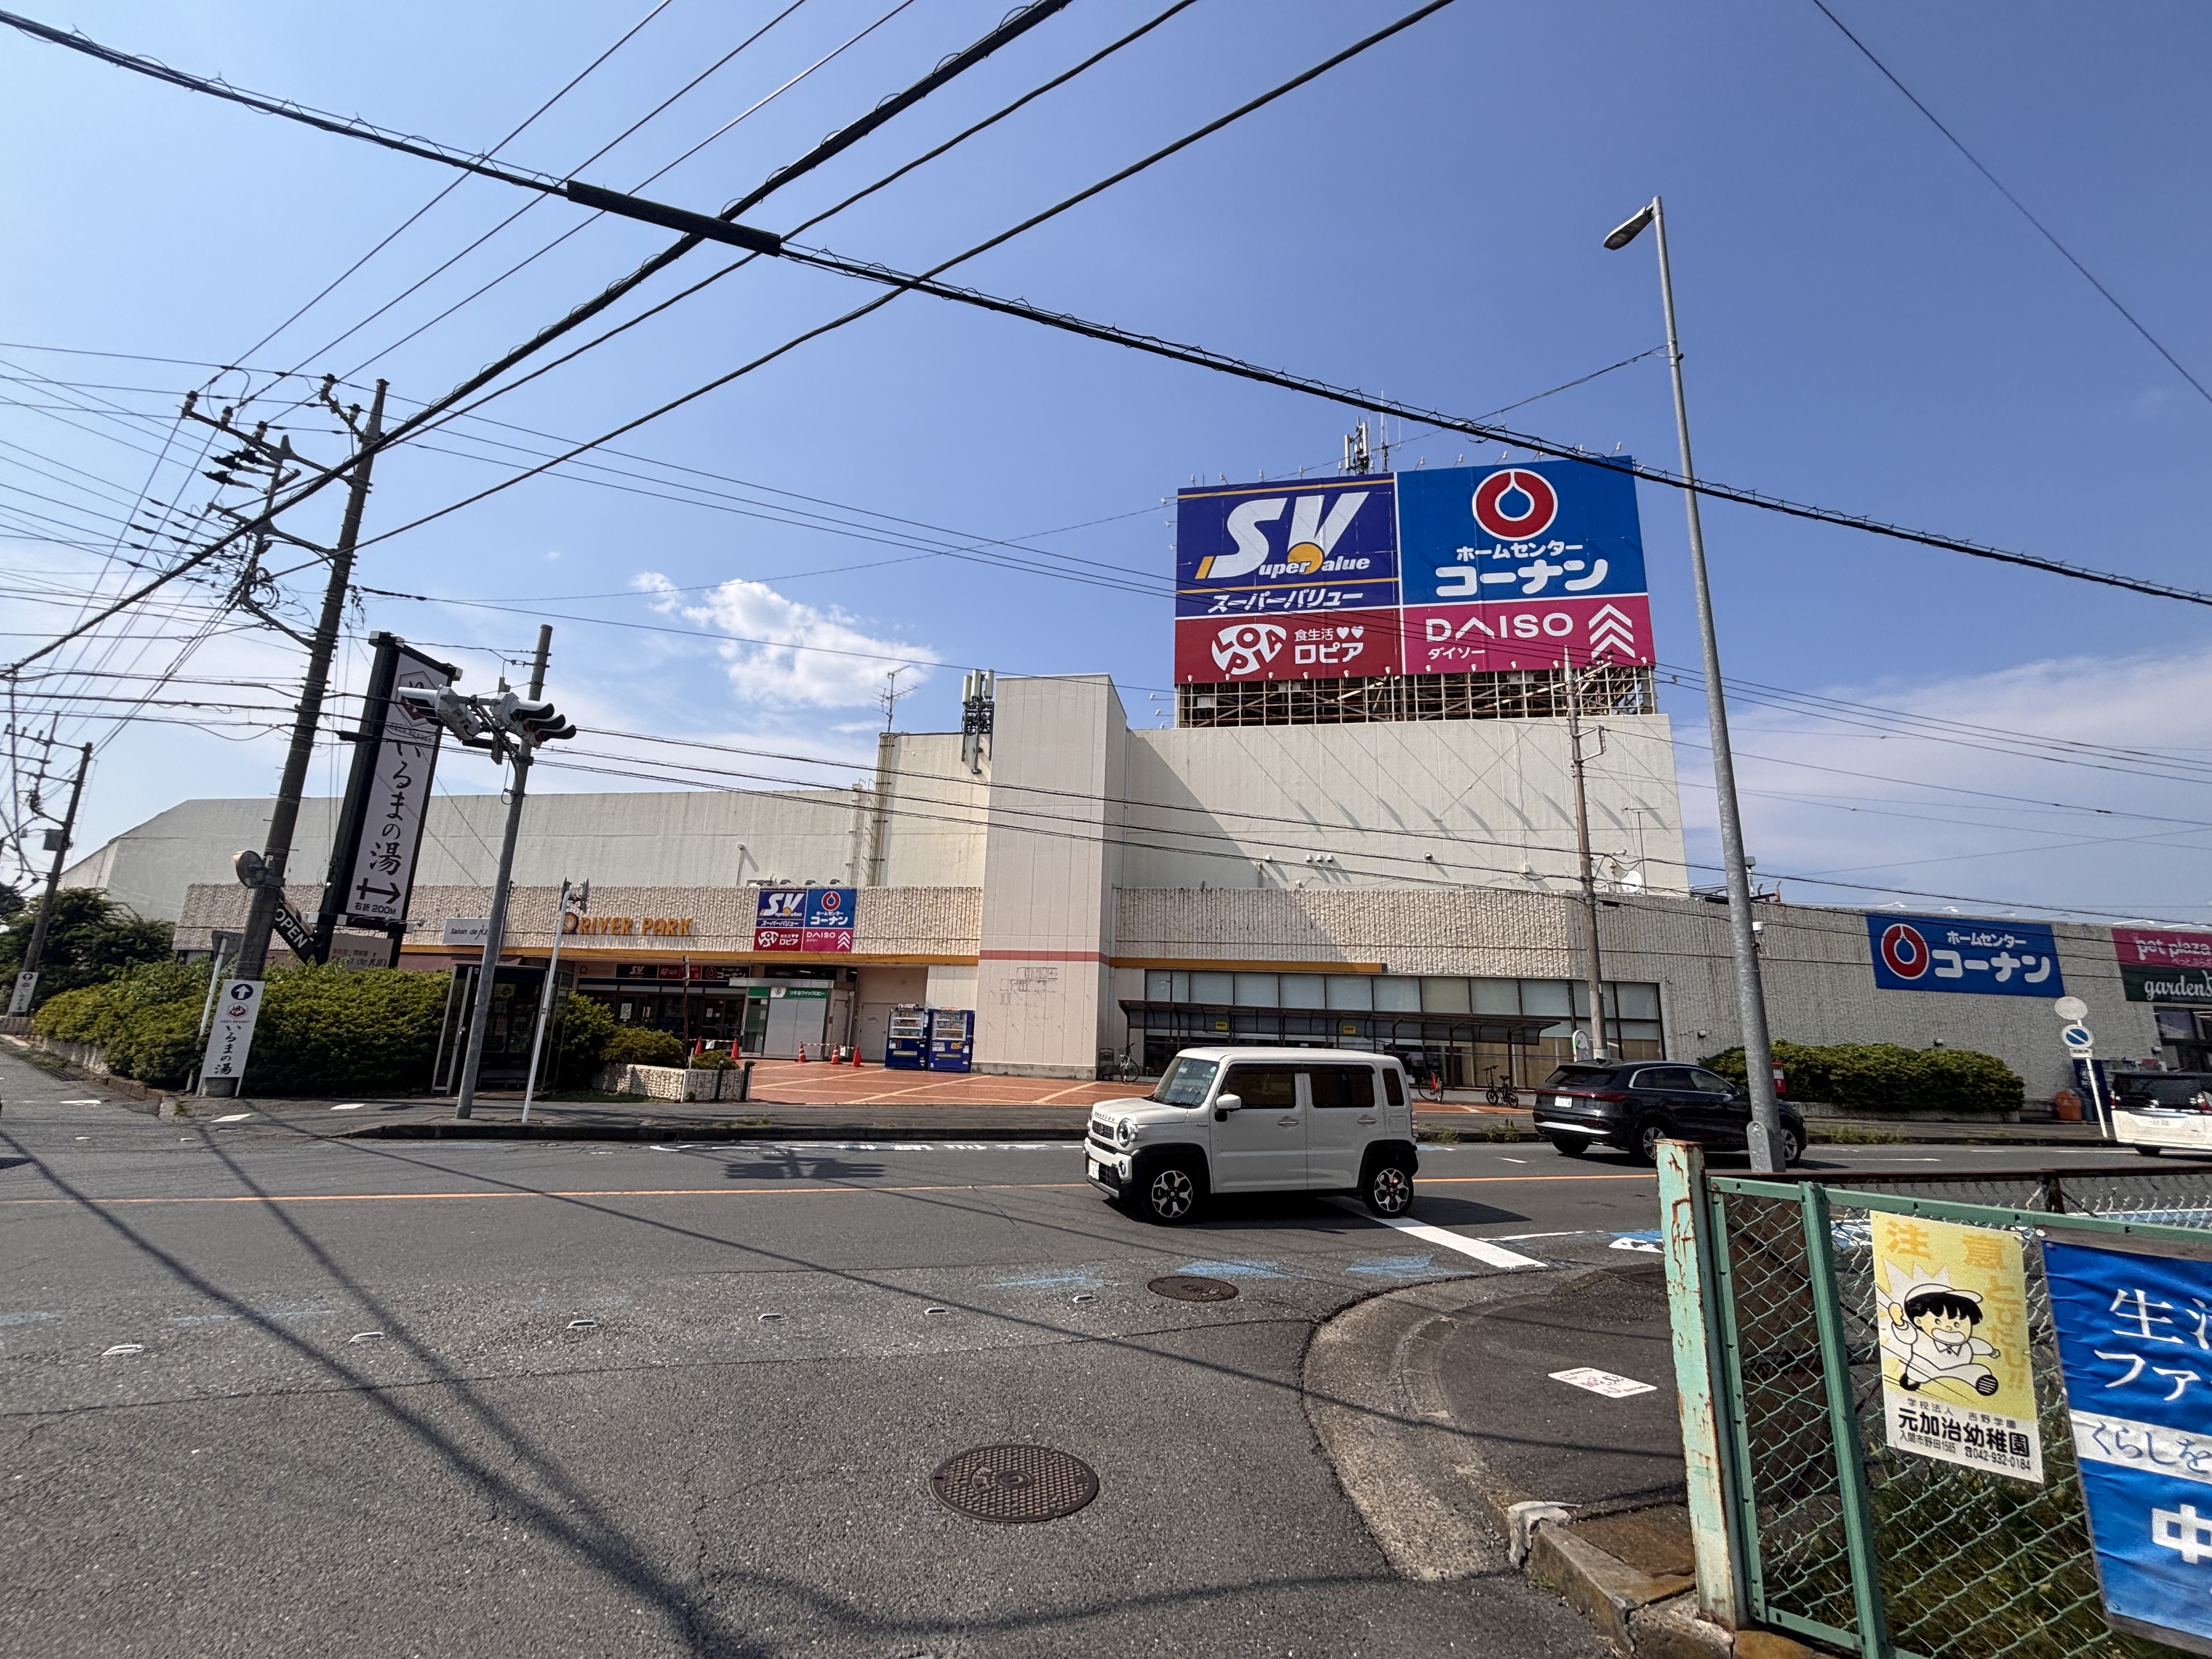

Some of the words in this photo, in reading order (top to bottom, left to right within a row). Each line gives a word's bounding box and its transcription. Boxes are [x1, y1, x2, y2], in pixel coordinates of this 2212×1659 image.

[1457, 540, 1583, 562] ホームセンター
[1435, 559, 1608, 596] コーナン
[1207, 589, 1364, 613] スーパーバリュー
[1294, 628, 1334, 642] 食生活
[1426, 612, 1574, 642] DAISO
[1295, 641, 1364, 664] ロピア
[1427, 647, 1485, 660] ダイソー
[369, 742, 421, 876] いるまの湯
[275, 908, 308, 948] OPEN
[579, 917, 633, 934] RIVER
[641, 917, 693, 935] PARK
[810, 916, 849, 926] コーナン
[1946, 930, 2027, 948] ホームセンター
[1932, 950, 2051, 983] コーナン
[215, 1025, 241, 1075] いるまの湯
[1908, 1397, 1954, 1417] 学校法人
[1898, 1407, 2029, 1458] 元加治幼稚園
